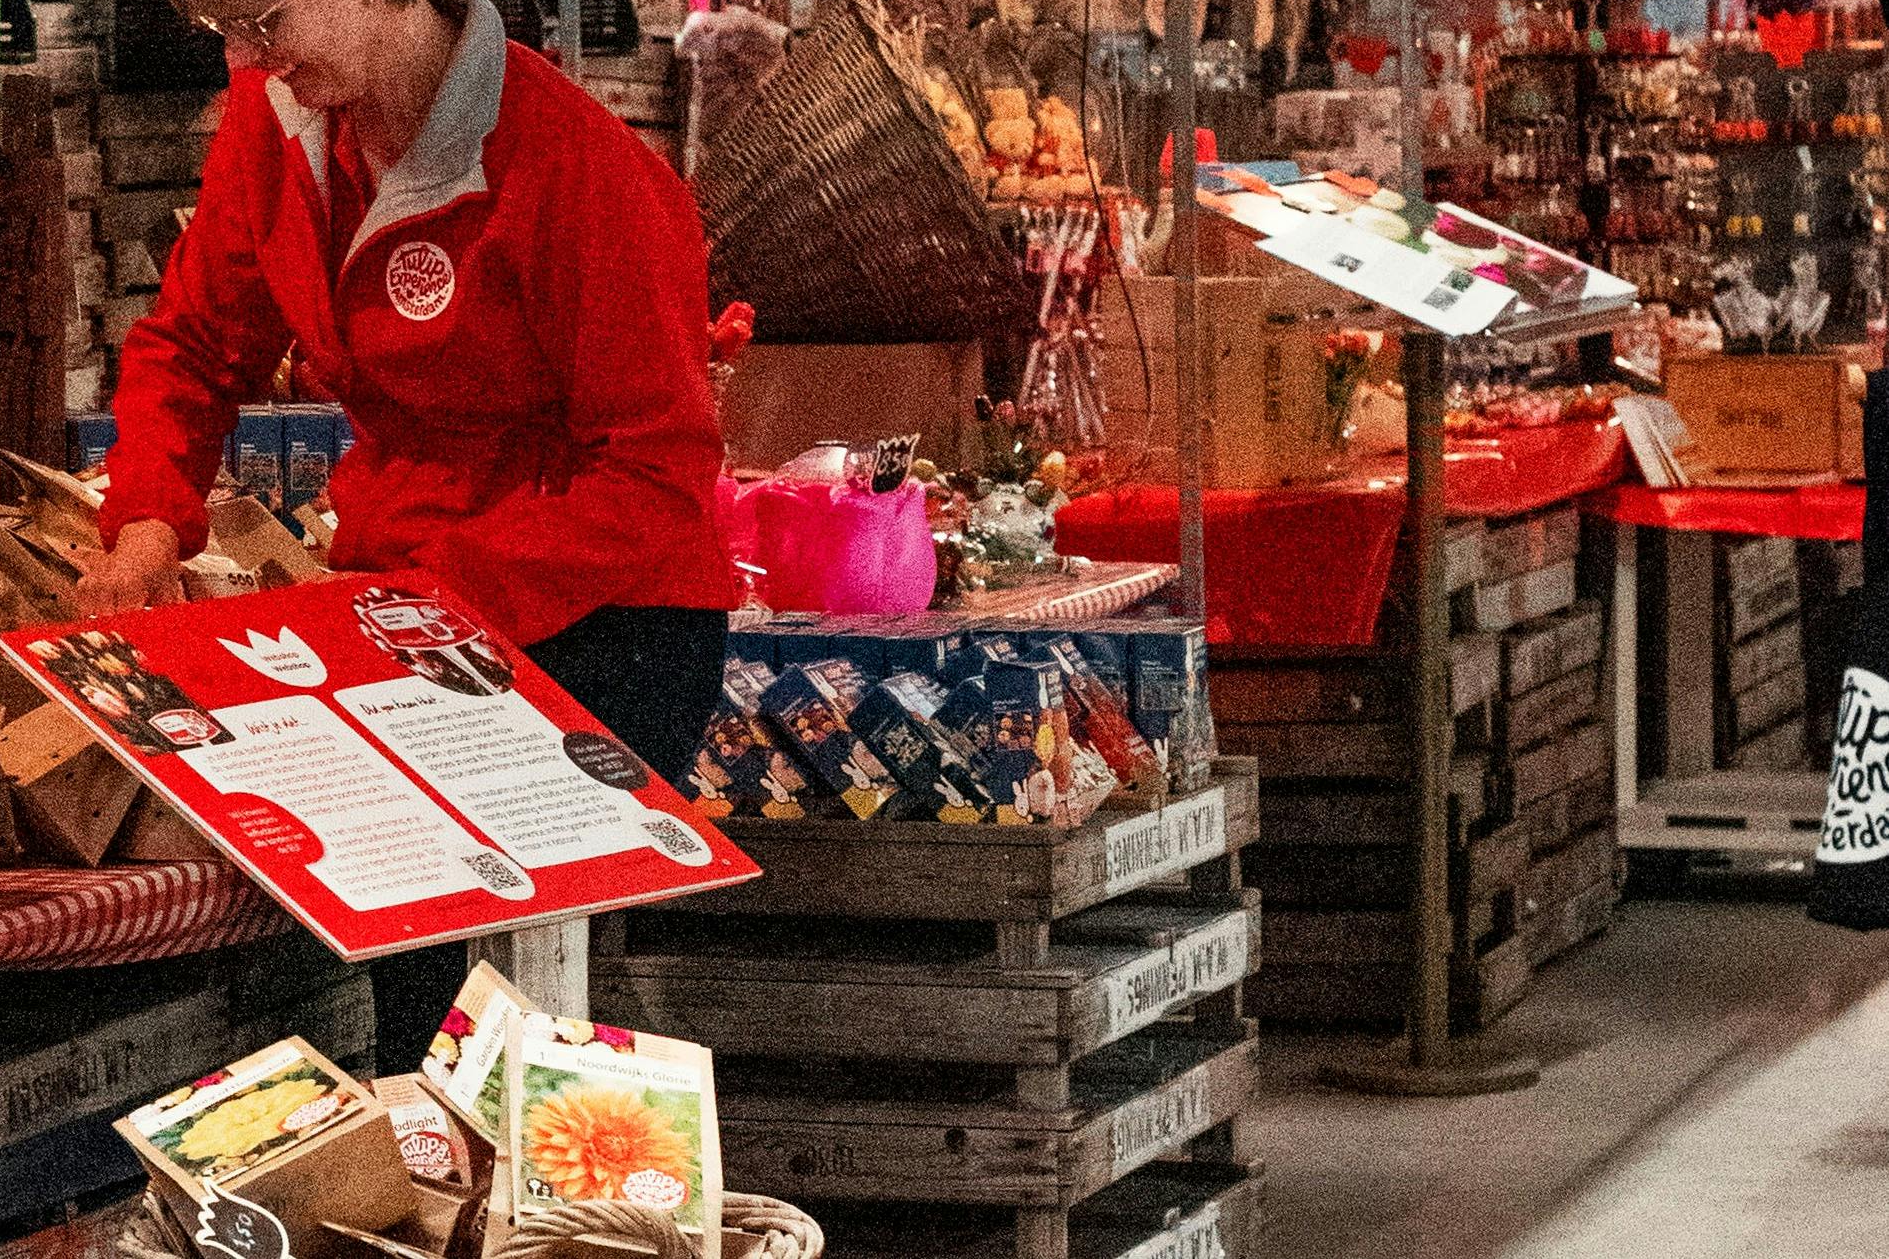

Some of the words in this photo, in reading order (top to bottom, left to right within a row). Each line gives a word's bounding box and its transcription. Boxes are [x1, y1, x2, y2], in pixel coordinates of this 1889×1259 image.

[577, 1057, 648, 1080] Noordwijks
[652, 1071, 692, 1087] Glorie
[394, 1114, 438, 1134] odlight
